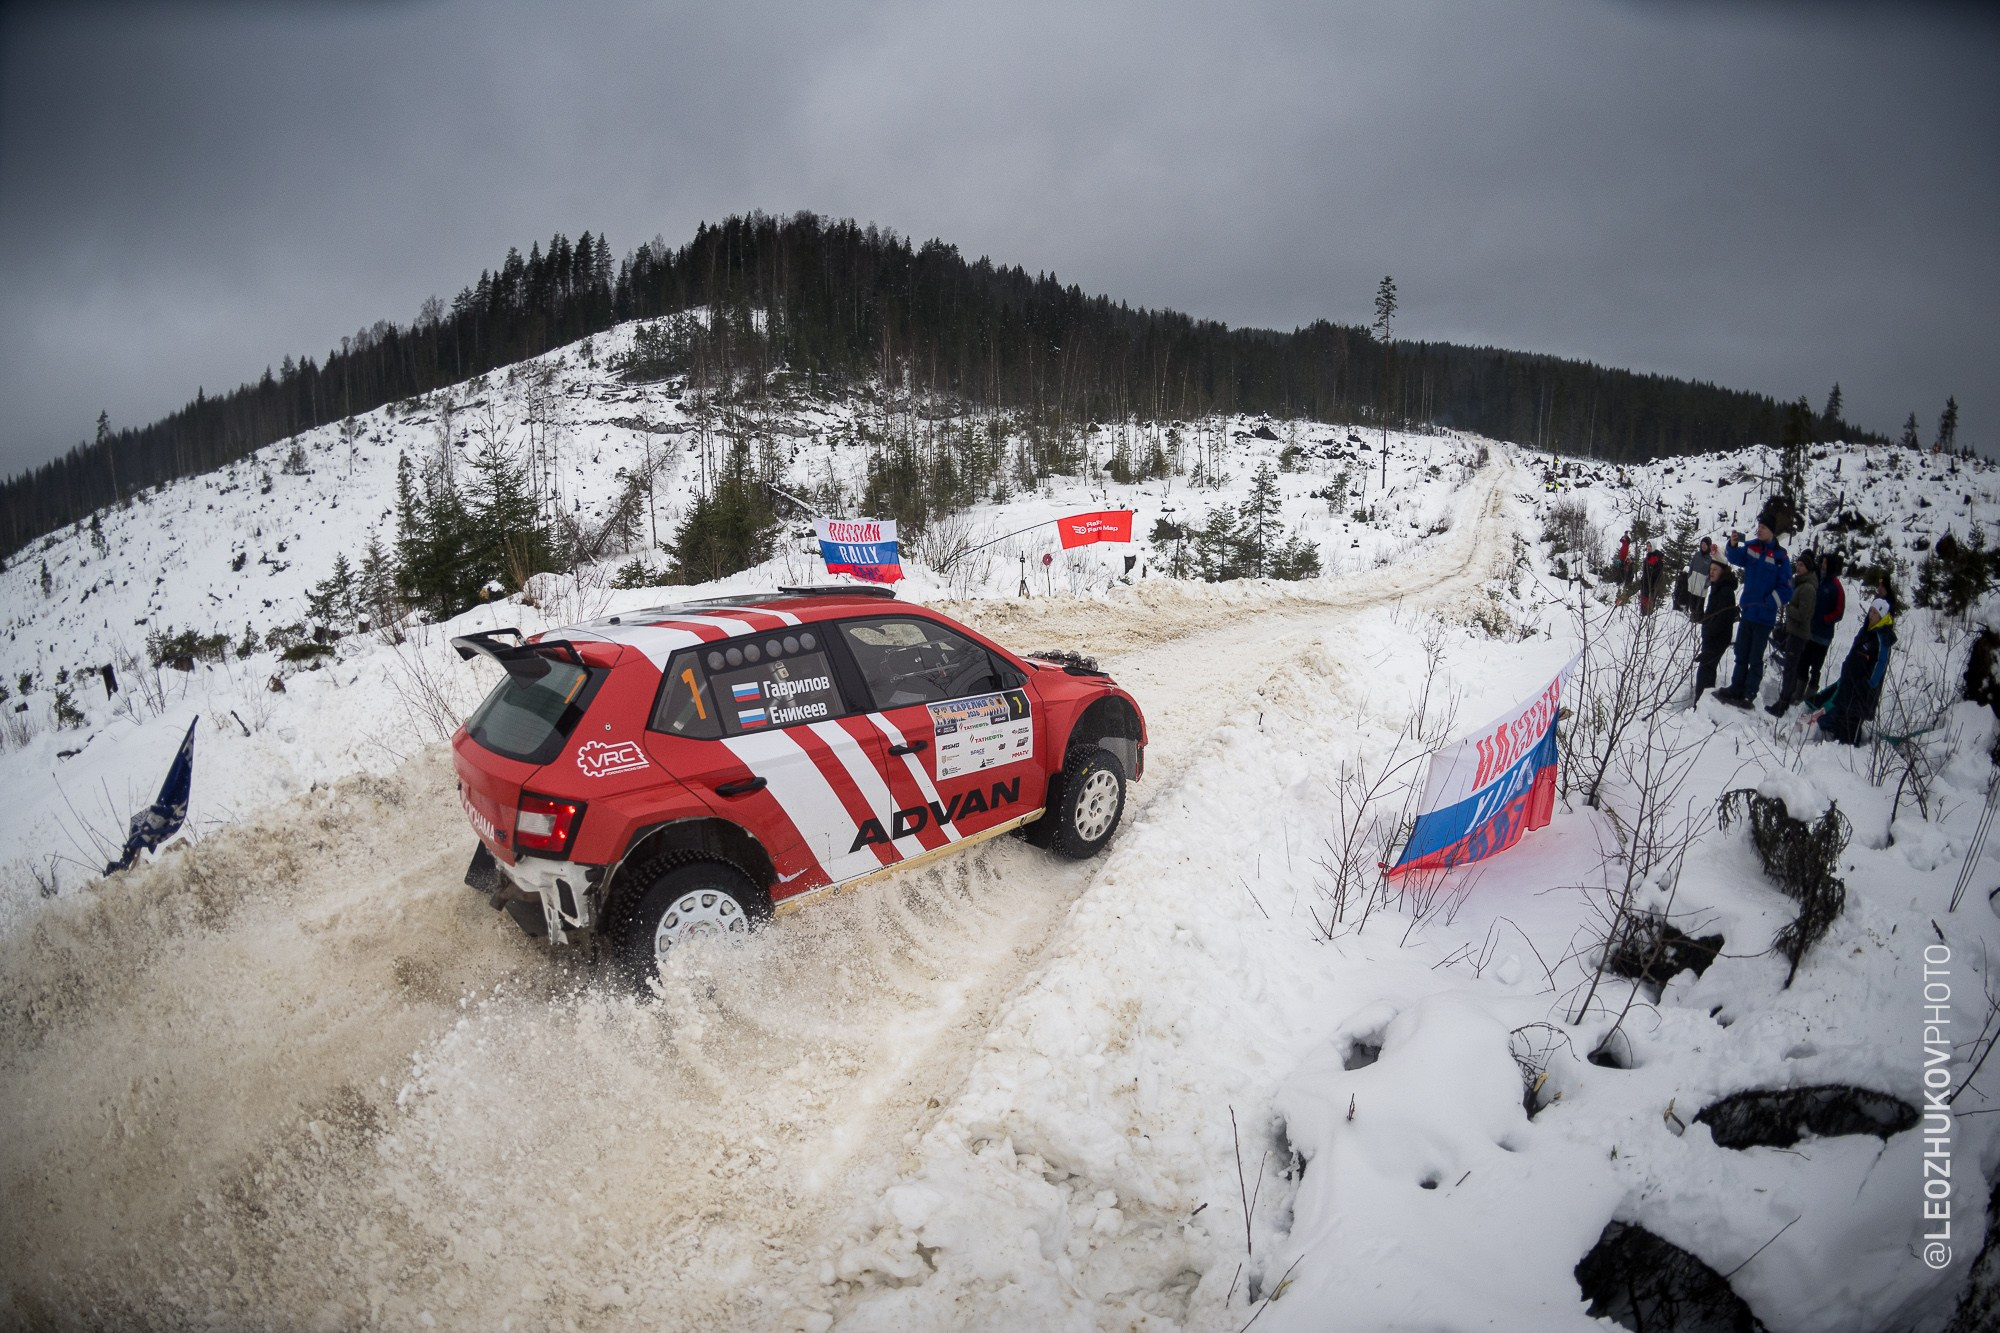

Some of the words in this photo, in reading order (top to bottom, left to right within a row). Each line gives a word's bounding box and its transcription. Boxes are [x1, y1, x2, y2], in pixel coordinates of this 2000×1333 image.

[828, 522, 881, 542] RUSSIAN
[838, 545, 880, 565] RALLY
[681, 667, 707, 721] 1
[762, 675, 831, 699] Гаврилов
[769, 702, 828, 725] Еникеев
[974, 733, 1004, 744] ТАТНЕФТЬ
[587, 748, 636, 768] VRC
[848, 776, 1021, 854] ADVAN
